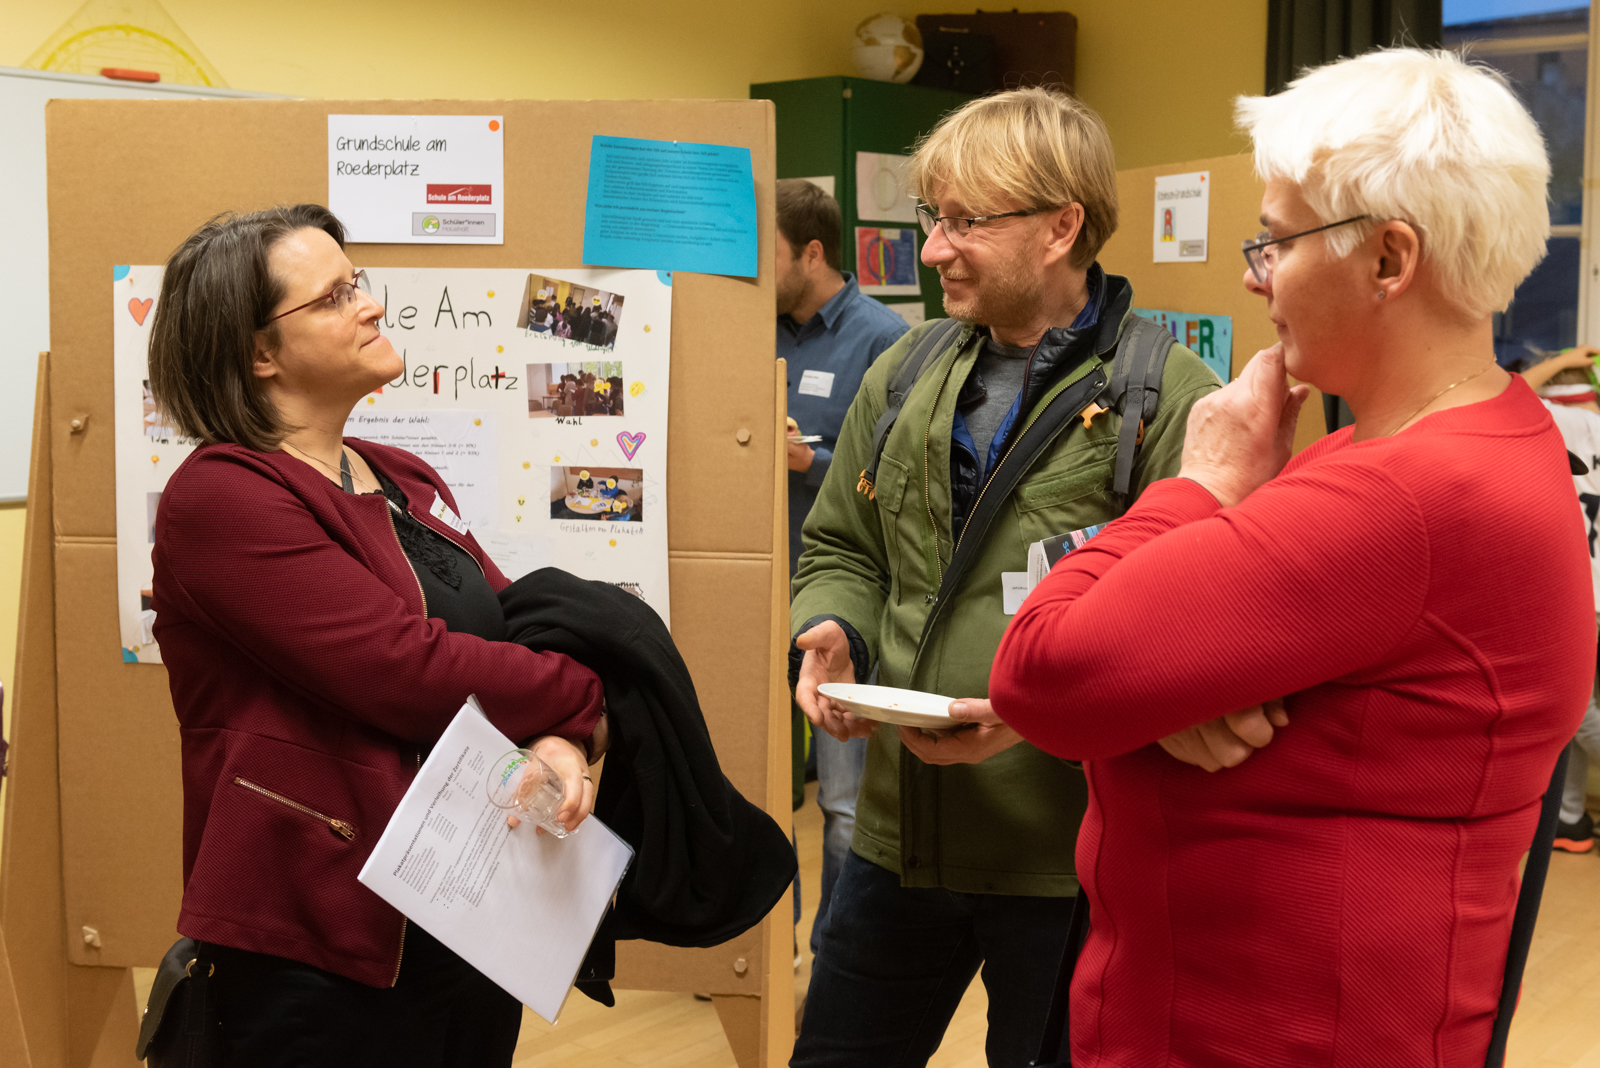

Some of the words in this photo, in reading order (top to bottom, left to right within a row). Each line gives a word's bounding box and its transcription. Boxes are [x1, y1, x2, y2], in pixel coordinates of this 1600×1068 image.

[336, 135, 421, 151] Grundschule
[426, 138, 447, 152] am
[336, 160, 420, 180] Roederplatz
[428, 193, 446, 202] Schule
[457, 194, 490, 203] Roederplatz
[434, 285, 492, 330] Am
[387, 348, 518, 401] derplatz
[358, 416, 389, 424] Ergebnis
[555, 416, 583, 426] Wahl
[392, 820, 426, 876] Plakatpräsentationen
[428, 780, 448, 808] Verleihung
[451, 745, 470, 772] Zertifikate
